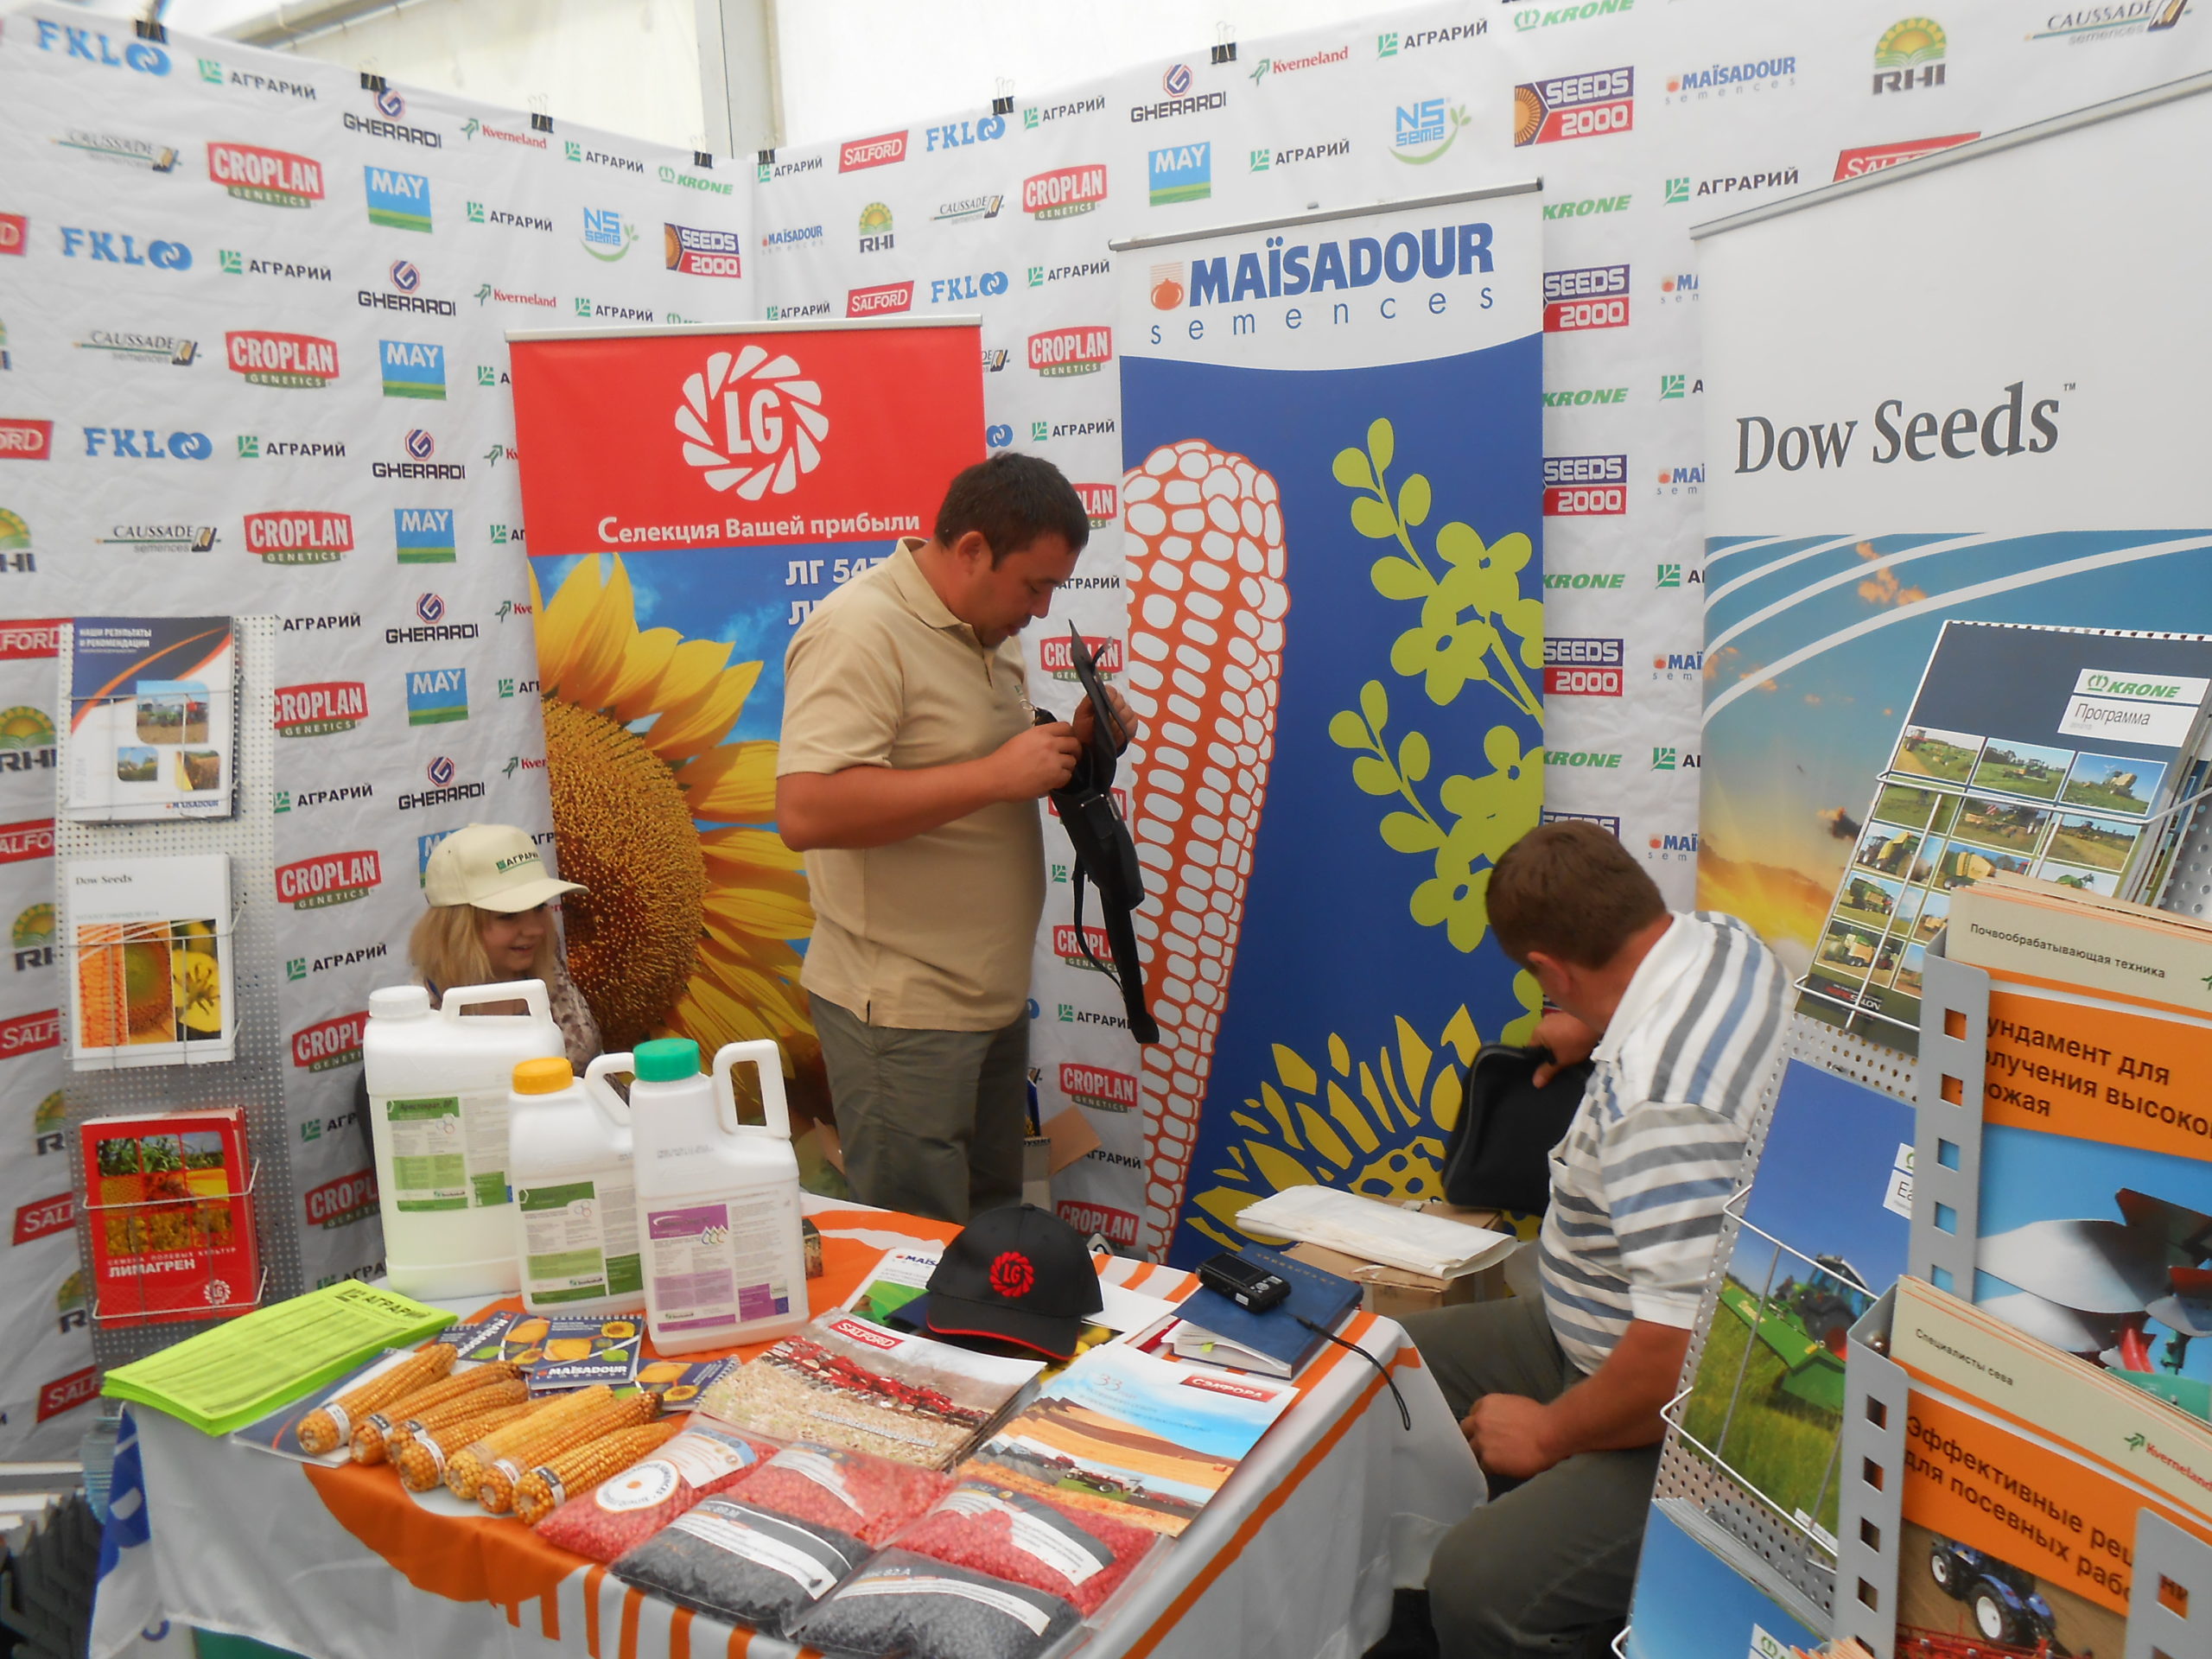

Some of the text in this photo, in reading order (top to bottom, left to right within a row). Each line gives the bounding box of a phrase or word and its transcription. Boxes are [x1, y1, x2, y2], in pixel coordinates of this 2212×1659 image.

[1541, 0, 1632, 27] KRONE
[35, 19, 121, 67] FKL
[1404, 18, 1488, 49] АГРАРИЙ
[1273, 46, 1348, 74] Kverneland
[1681, 56, 1796, 90] MAÏSADOUR
[231, 71, 316, 100] АГРАРИЙ
[1546, 70, 1629, 105] SEEDS
[1665, 77, 1796, 105] semences
[1872, 64, 1946, 95] RHI
[1042, 97, 1105, 122] АГРАРИЙ
[1131, 92, 1226, 123] GHERARDI
[1396, 98, 1444, 131] NS
[1561, 105, 1628, 136] 2000
[343, 111, 442, 148] GHERARDI
[482, 124, 547, 149] Kverneland
[926, 123, 975, 151] FKL
[1396, 126, 1444, 146] seme
[586, 151, 644, 174] АГРАРИЙ
[845, 139, 902, 166] SALFORD
[1155, 145, 1205, 173] MAY
[1274, 138, 1350, 165] АГРАРИЙ
[213, 146, 319, 193] CROPLAN
[774, 156, 823, 177] АГРАРИЙ
[372, 170, 423, 200] MAY
[677, 174, 733, 195] KRONE
[1026, 169, 1103, 207] CROPLAN
[1697, 167, 1798, 196] АГРАРИЙ
[232, 187, 307, 207] GENETICS
[940, 195, 988, 215] CAUSSADE
[1543, 194, 1631, 220] KRONE
[490, 209, 552, 232] АГРАРИЙ
[583, 207, 620, 234] NS
[1039, 202, 1092, 219] GENETICS
[60, 226, 145, 265] FKL
[585, 230, 620, 246] seme
[681, 228, 736, 251] SEEDS
[860, 234, 894, 252] RHI
[249, 258, 332, 281] АГРАРИЙ
[690, 255, 738, 275] 2000
[1047, 259, 1109, 281] АГРАРИЙ
[1190, 222, 1493, 307] MAÏSADOUR
[931, 274, 977, 303] FKL
[1544, 268, 1624, 297] SEEDS
[359, 291, 456, 316] GHERARDI
[493, 289, 556, 308] Kverneland
[780, 303, 830, 319] АГРАРИЙ
[851, 289, 907, 312] SALFORD
[595, 304, 653, 322] АГРАРИЙ
[1151, 287, 1493, 344] semences
[1560, 302, 1624, 327] 2000
[91, 330, 173, 350] CAUSSADE
[1032, 331, 1107, 364] CROPLAN
[232, 336, 334, 372] CROPLAN
[386, 344, 438, 368] MAY
[251, 372, 321, 387] GENETICS
[1043, 363, 1096, 377] GENETICS
[1542, 388, 1628, 407] KRONE
[724, 389, 783, 454] LG
[1052, 418, 1115, 436] АГРАРИЙ
[1734, 416, 1858, 473] Dow
[1872, 380, 2059, 463] Seeds
[84, 427, 165, 458] FKL
[266, 441, 346, 457] АГРАРИЙ
[372, 462, 466, 480] GHERARDI
[1544, 458, 1621, 480] SEEDS
[1558, 490, 1621, 512] 2000
[113, 524, 194, 537] CAUSSADE
[251, 518, 347, 547] CROPLAN
[401, 511, 448, 531] MAY
[598, 512, 919, 543] Селекция Вашей прибыли
[267, 550, 337, 563] GENETICS
[785, 560, 824, 586] ЛГ
[1543, 575, 1624, 588] KRONE
[283, 613, 360, 631] АГРАРИЙ
[386, 624, 479, 644] GHERARDI
[1543, 639, 1619, 662] SEEDS
[412, 671, 461, 695] MAY
[1556, 671, 1618, 692] 2000
[2107, 681, 2181, 698] KRONE
[275, 687, 363, 721] CROPLAN
[2075, 703, 2150, 725] Программа
[285, 721, 353, 737] GENETICS
[297, 785, 373, 807] АГРАРИЙ
[399, 782, 485, 810] GHERARDI
[281, 855, 377, 897] CROPLAN
[299, 889, 365, 908] GENETICS
[313, 943, 387, 972] АГРАРИЙ
[1971, 923, 2165, 977] Почвообрабатывающая техника
[297, 1020, 363, 1060] CROPL
[1987, 1015, 2170, 1085] ундамент для
[1064, 1067, 1134, 1102] CROPLAN
[1987, 1083, 2050, 1116] ожая
[311, 1177, 377, 1218] CROPL
[109, 1259, 196, 1278] ЛИМАГРЕН
[1002, 1267, 1021, 1284] LG
[838, 1321, 895, 1347] SALFORD
[1916, 1328, 2013, 1385] Специалисты сева
[1907, 1415, 2083, 1534] Эффективные
[1904, 1451, 1943, 1484] для
[1950, 1478, 2069, 1562] посевных
